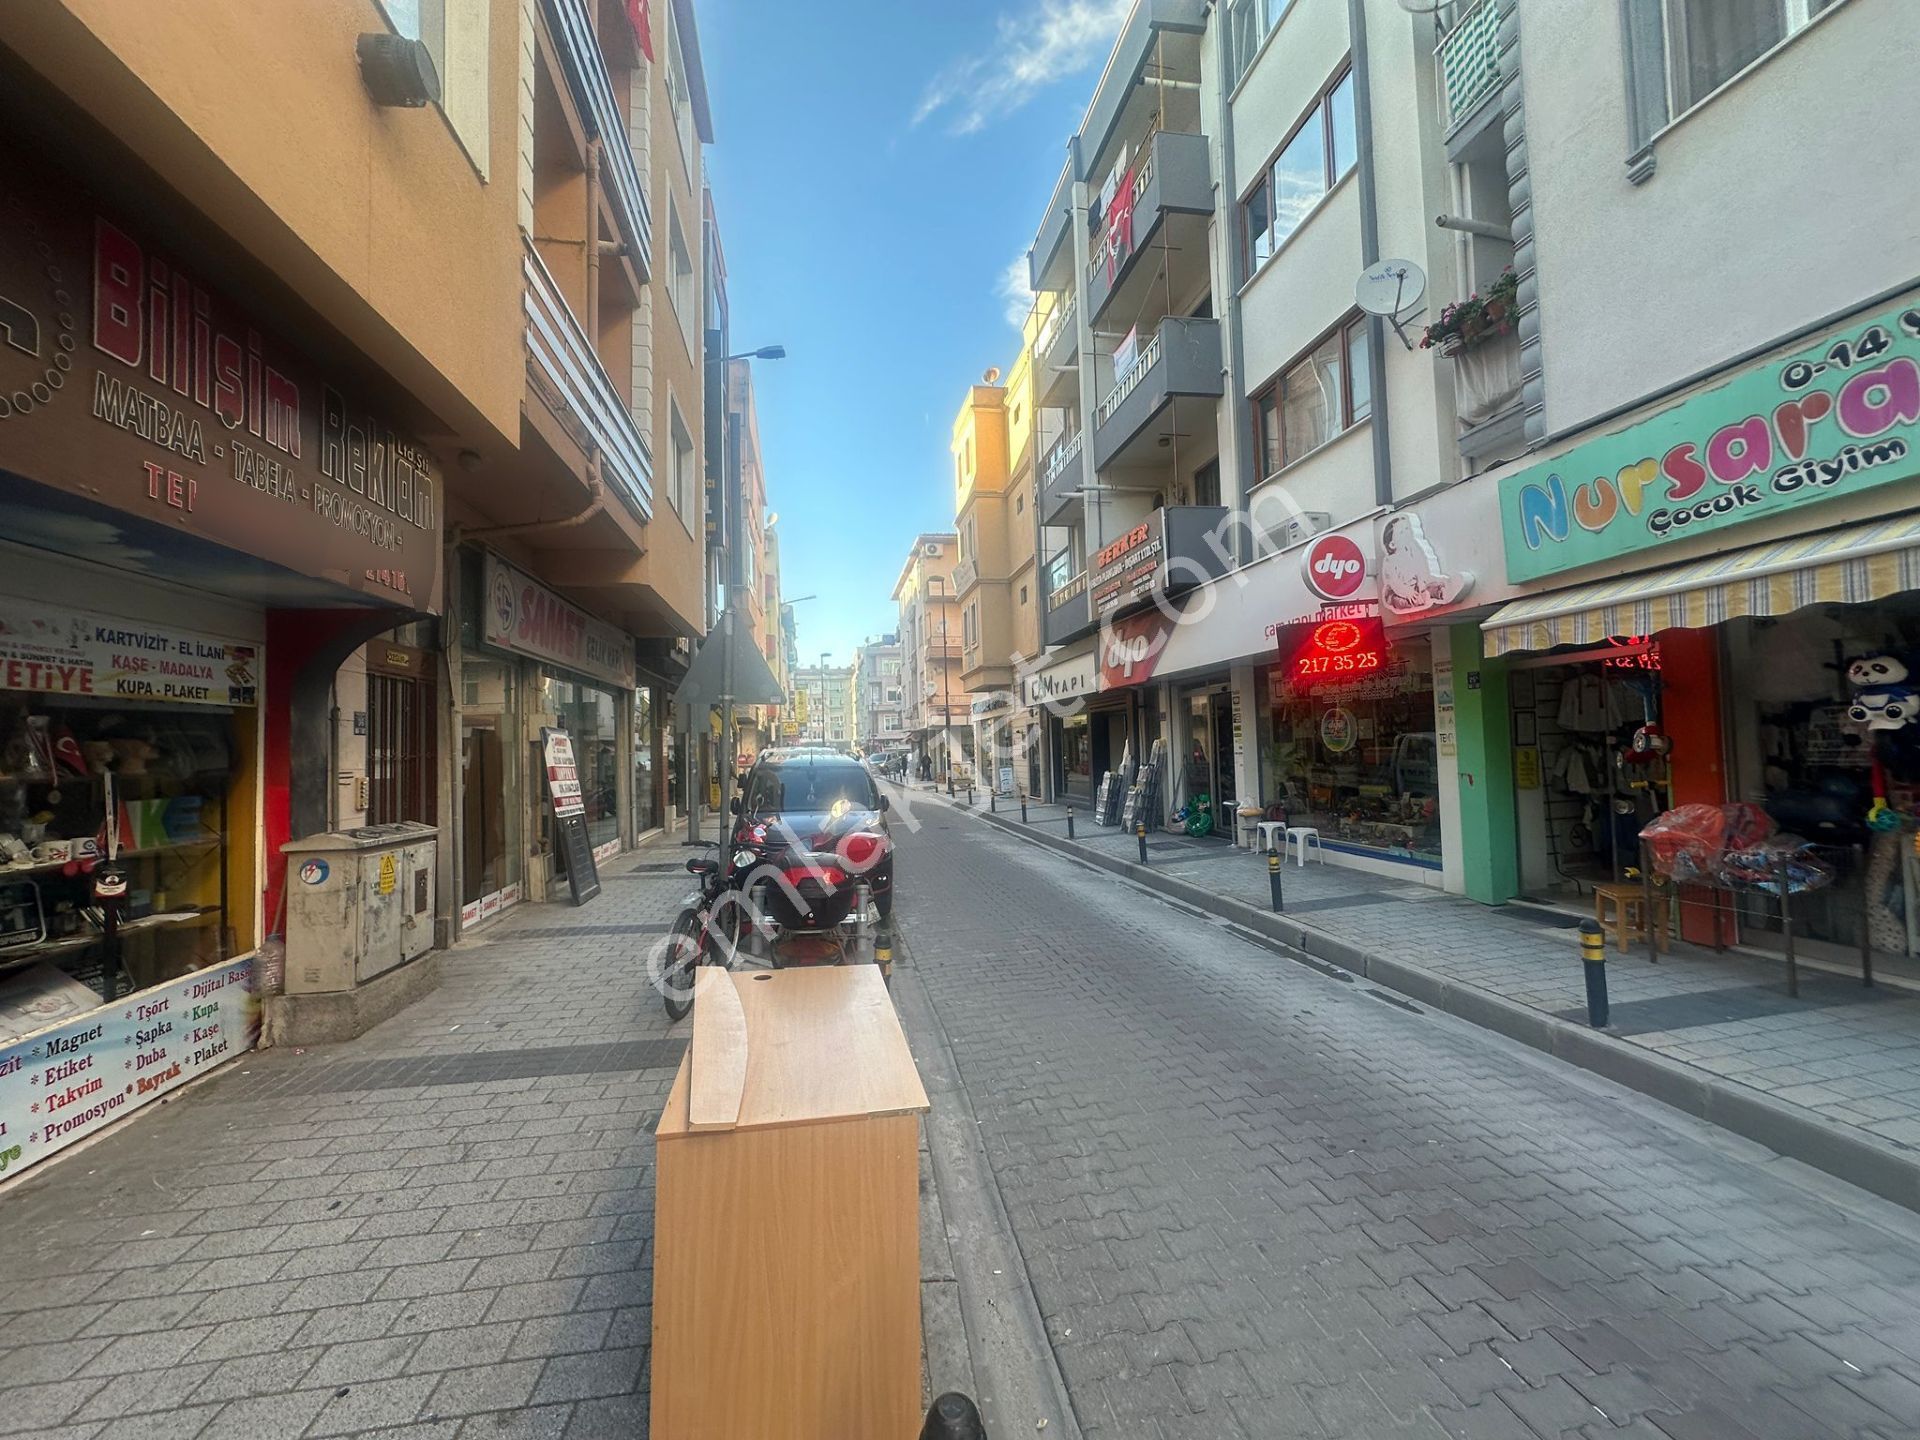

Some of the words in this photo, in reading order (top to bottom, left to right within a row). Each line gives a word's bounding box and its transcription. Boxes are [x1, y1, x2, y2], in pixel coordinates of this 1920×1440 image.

[1783, 327, 1891, 390] 0-14
[93, 370, 206, 465] MATBAA
[231, 440, 297, 504] TABELA
[314, 482, 396, 552] PROMOSYON
[322, 382, 435, 531] Reklam
[1519, 357, 1920, 551] Nursara
[1649, 486, 1763, 537] Çocuk
[1772, 437, 1908, 492] Giyim
[1097, 522, 1150, 570] BERKER
[1314, 553, 1361, 579] dyo
[96, 627, 169, 652] KARTVİZİT
[179, 641, 193, 657] EL
[196, 641, 225, 661] İLANI
[1107, 626, 1149, 678] dyo
[111, 655, 148, 675] KAŞE
[159, 661, 214, 681] MADALYA
[1299, 656, 1330, 675] 217
[1333, 654, 1354, 671] 35
[1357, 651, 1378, 669] 25
[117, 679, 152, 695] KUPA
[164, 683, 209, 700] PLAKET
[192, 974, 225, 999] Dijital
[192, 1001, 219, 1022] Kupa
[45, 1022, 103, 1059] Magnet
[135, 1021, 173, 1050] Şapka
[192, 1023, 220, 1044] Kaşe
[136, 1047, 167, 1071] Duba
[194, 1038, 229, 1066] Plaket
[45, 1053, 94, 1087] Etiket
[136, 1061, 182, 1096] Bayrak
[45, 1077, 104, 1114] Takvim
[44, 1092, 126, 1144] Promosyon
